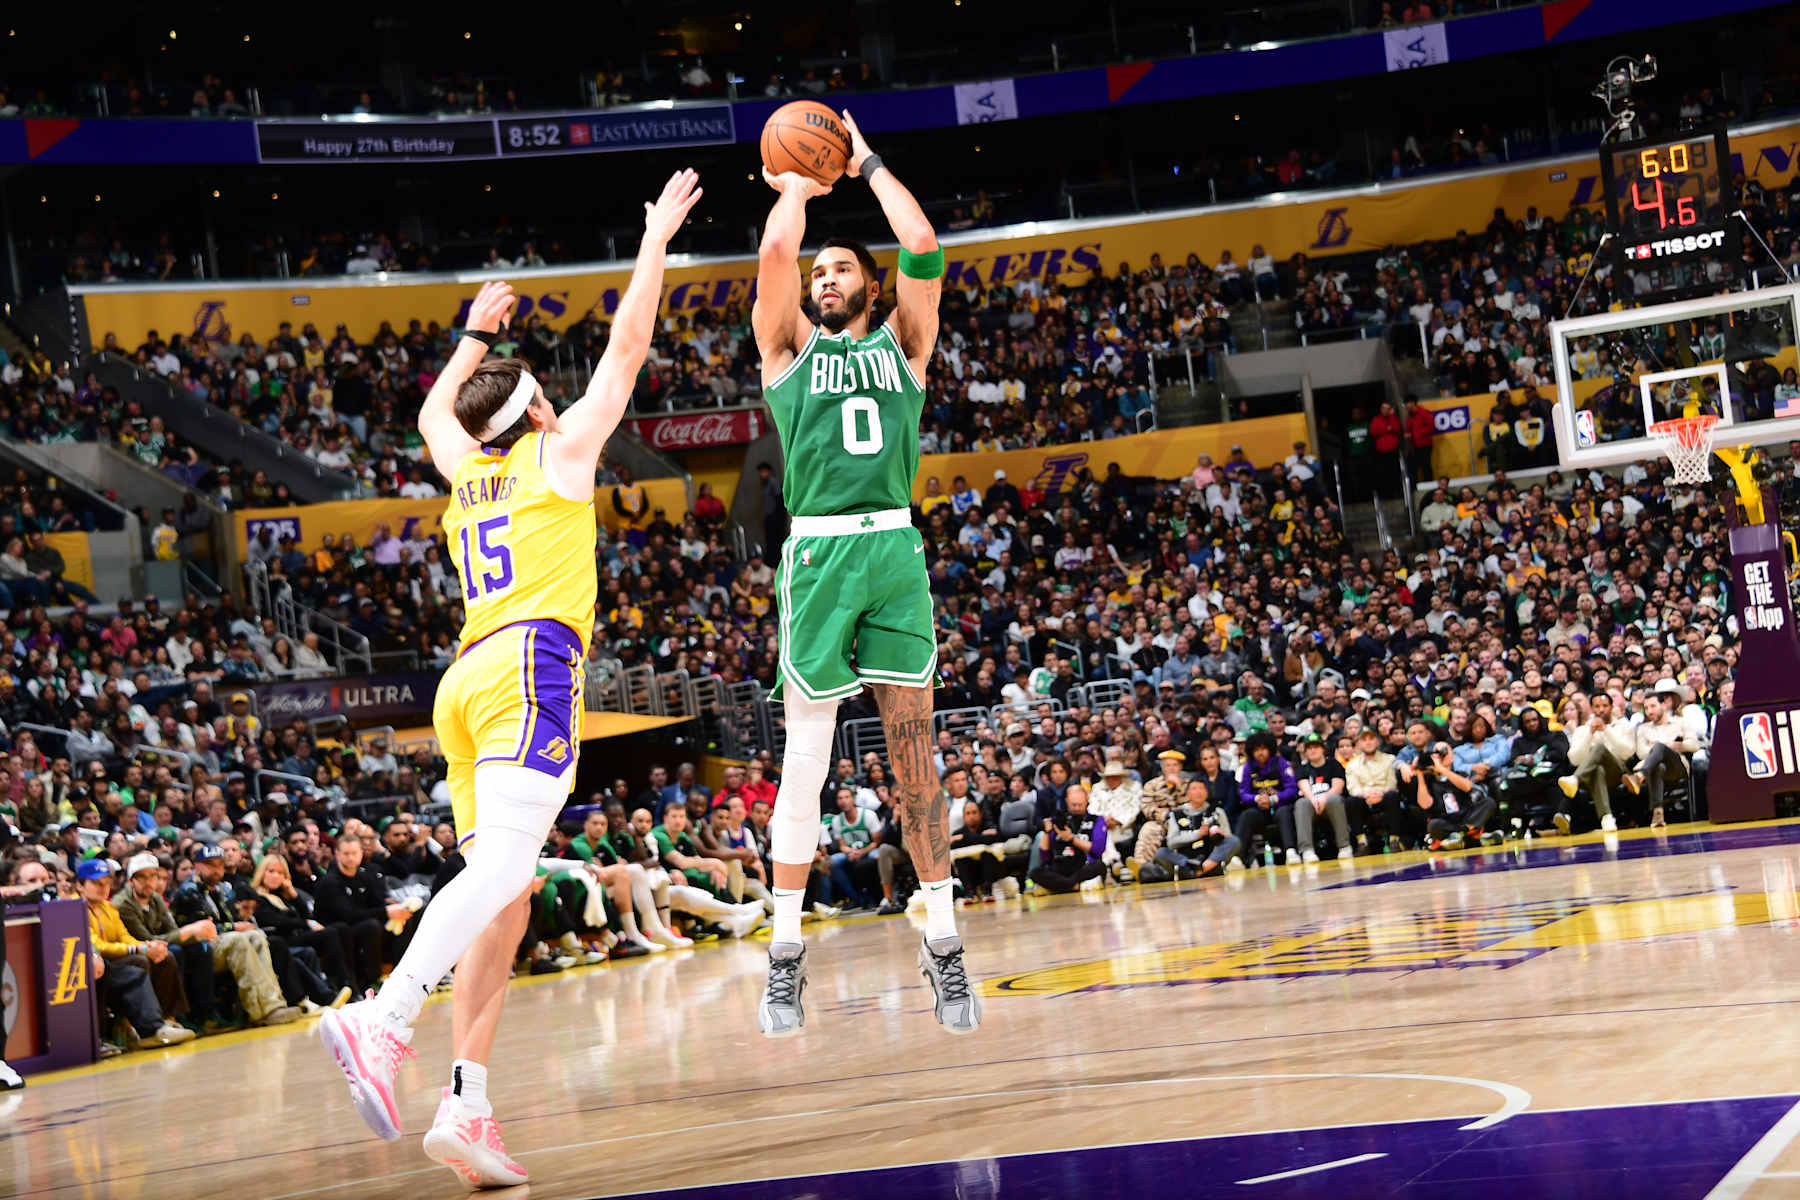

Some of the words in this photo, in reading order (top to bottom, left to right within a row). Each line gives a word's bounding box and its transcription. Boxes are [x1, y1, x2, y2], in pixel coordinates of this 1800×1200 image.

[304, 139, 352, 155] Happy
[357, 139, 389, 152] 27th
[392, 139, 454, 154] Birthday
[508, 125, 561, 147] 8:52
[1640, 143, 1689, 179] 6.0
[1631, 178, 1697, 230] 4.6
[1651, 230, 1726, 256] TISSOT
[810, 348, 903, 395] BOSTON
[841, 396, 884, 455] 0
[1434, 409, 1466, 431] 06
[457, 476, 517, 511] REAVES
[460, 514, 513, 601] 15
[1744, 561, 1769, 584] GET
[1747, 582, 1774, 605] THE
[1757, 606, 1784, 631] App
[344, 685, 414, 707] ULTRA
